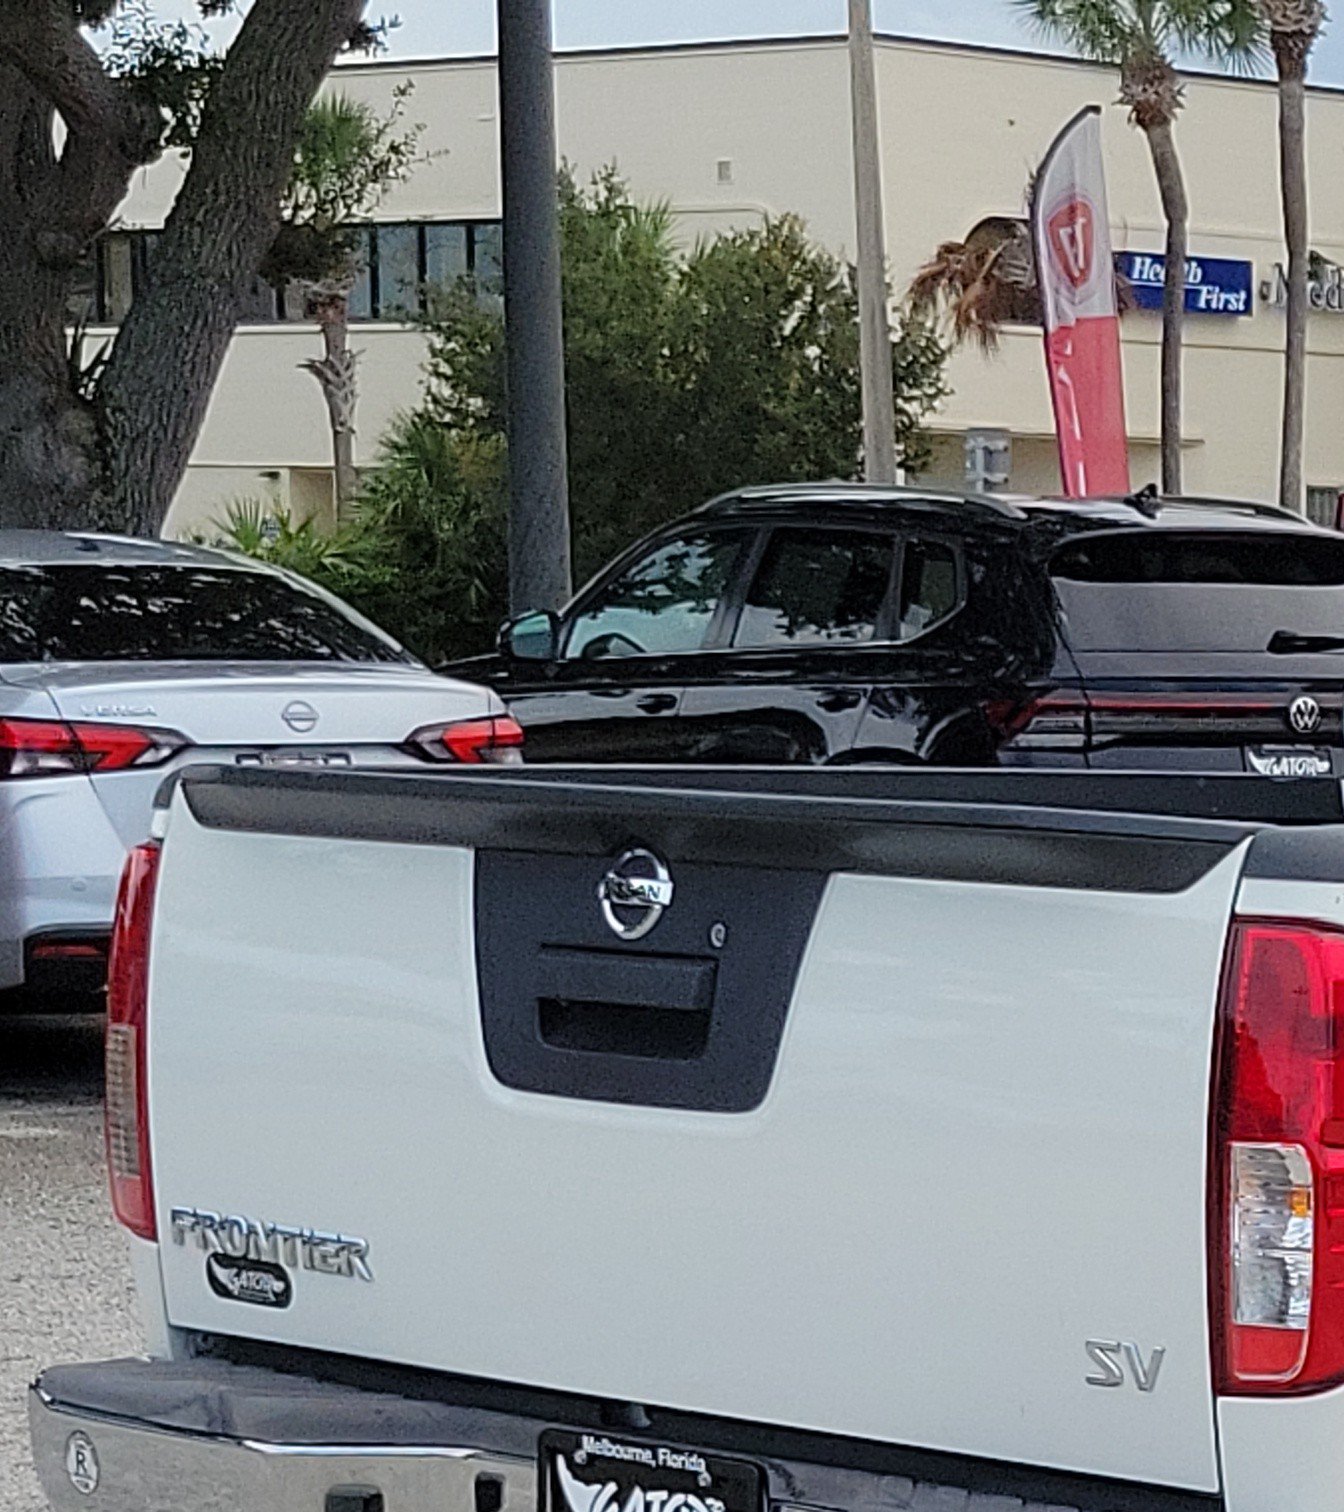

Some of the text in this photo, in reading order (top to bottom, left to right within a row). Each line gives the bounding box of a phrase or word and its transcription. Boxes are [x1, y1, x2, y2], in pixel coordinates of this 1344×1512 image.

[1199, 286, 1247, 311] First
[170, 1207, 374, 1283] FRONTIER
[1085, 1339, 1166, 1393] SV
[582, 1435, 706, 1473] Melbourne, Florida
